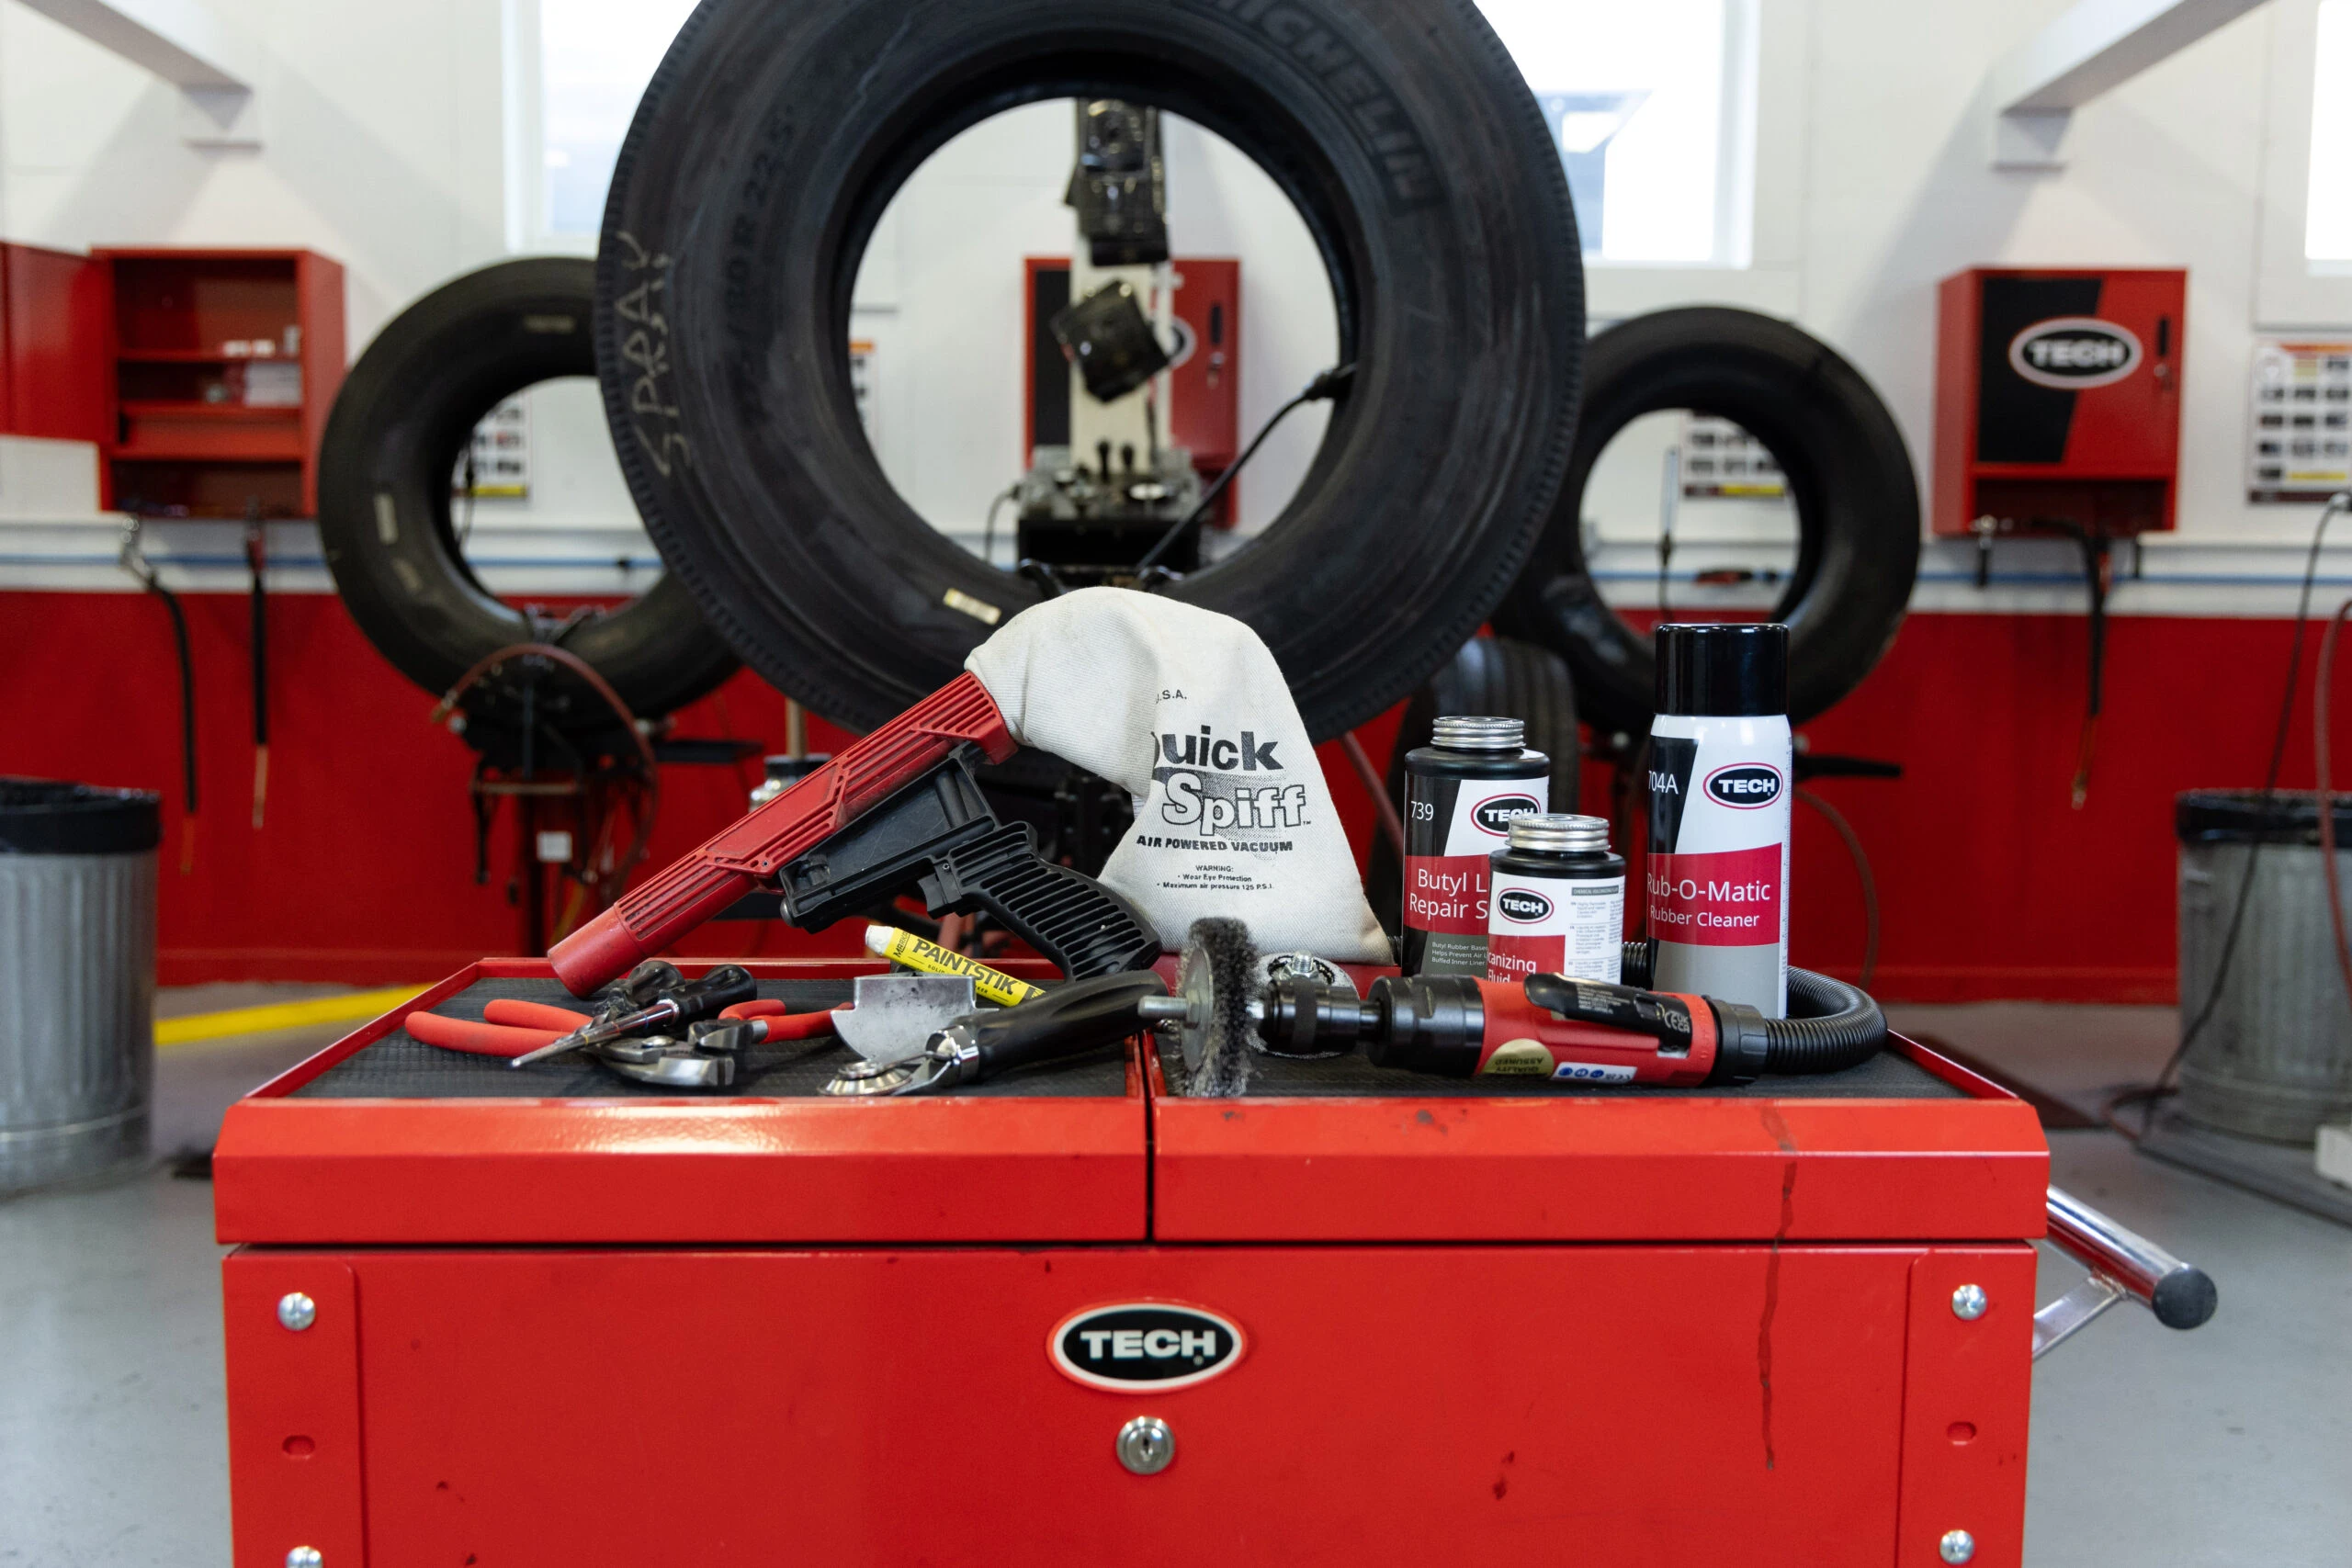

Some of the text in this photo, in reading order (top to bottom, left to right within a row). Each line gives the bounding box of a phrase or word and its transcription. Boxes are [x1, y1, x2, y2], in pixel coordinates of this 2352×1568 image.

[616, 230, 692, 478] SPRAY
[2029, 338, 2126, 367] TECH
[1151, 725, 1284, 771] uick
[1648, 770, 1679, 795] 704A
[1718, 778, 1776, 794] TECH
[1161, 772, 1306, 836] Spiff
[1411, 800, 1434, 821] 739
[1136, 835, 1293, 852] AIR POWERED VACUUM
[1418, 868, 1487, 897] Butyl L
[1647, 873, 1770, 902] Rub-O-Matic
[1410, 893, 1488, 920] Repair S
[1503, 899, 1544, 914] TECH
[1650, 905, 1759, 928] Rubber Cleaner
[912, 938, 1018, 996] PAINTSTIK
[1487, 951, 1537, 974] canizing
[1080, 1329, 1216, 1359] TECH
